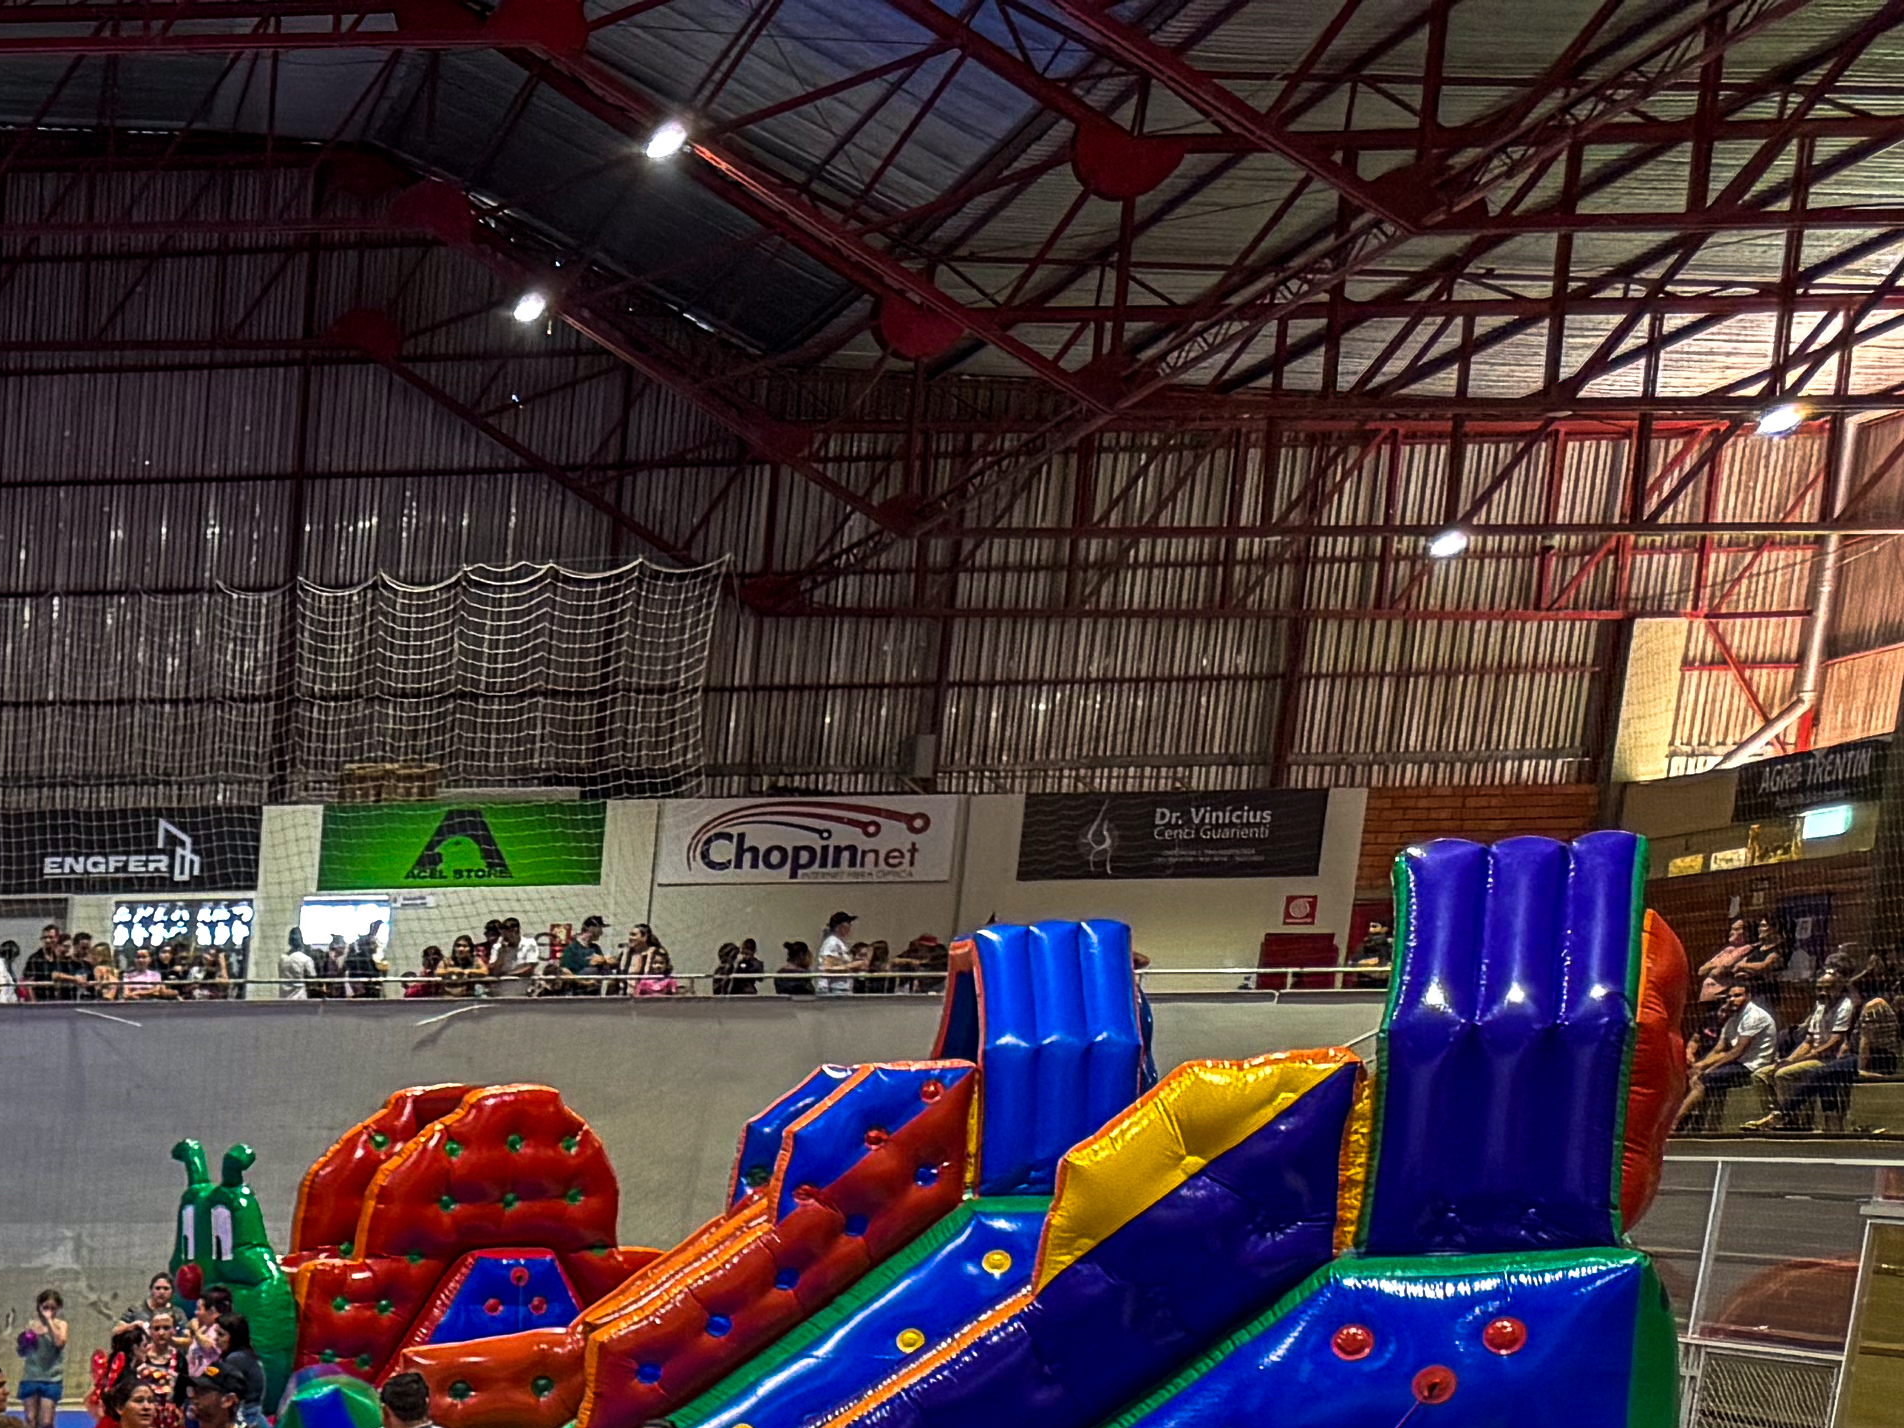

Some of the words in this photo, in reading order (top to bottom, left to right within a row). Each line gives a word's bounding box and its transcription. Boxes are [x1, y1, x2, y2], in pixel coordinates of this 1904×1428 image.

[1806, 747, 1872, 785] TRENTIN
[1154, 808, 1182, 825] Dr.
[1191, 806, 1272, 824] Vinícius
[1154, 825, 1196, 840] Cenci
[1200, 824, 1271, 840] Guarienti
[43, 855, 169, 873] ENGFER
[700, 832, 920, 879] Chopinnet
